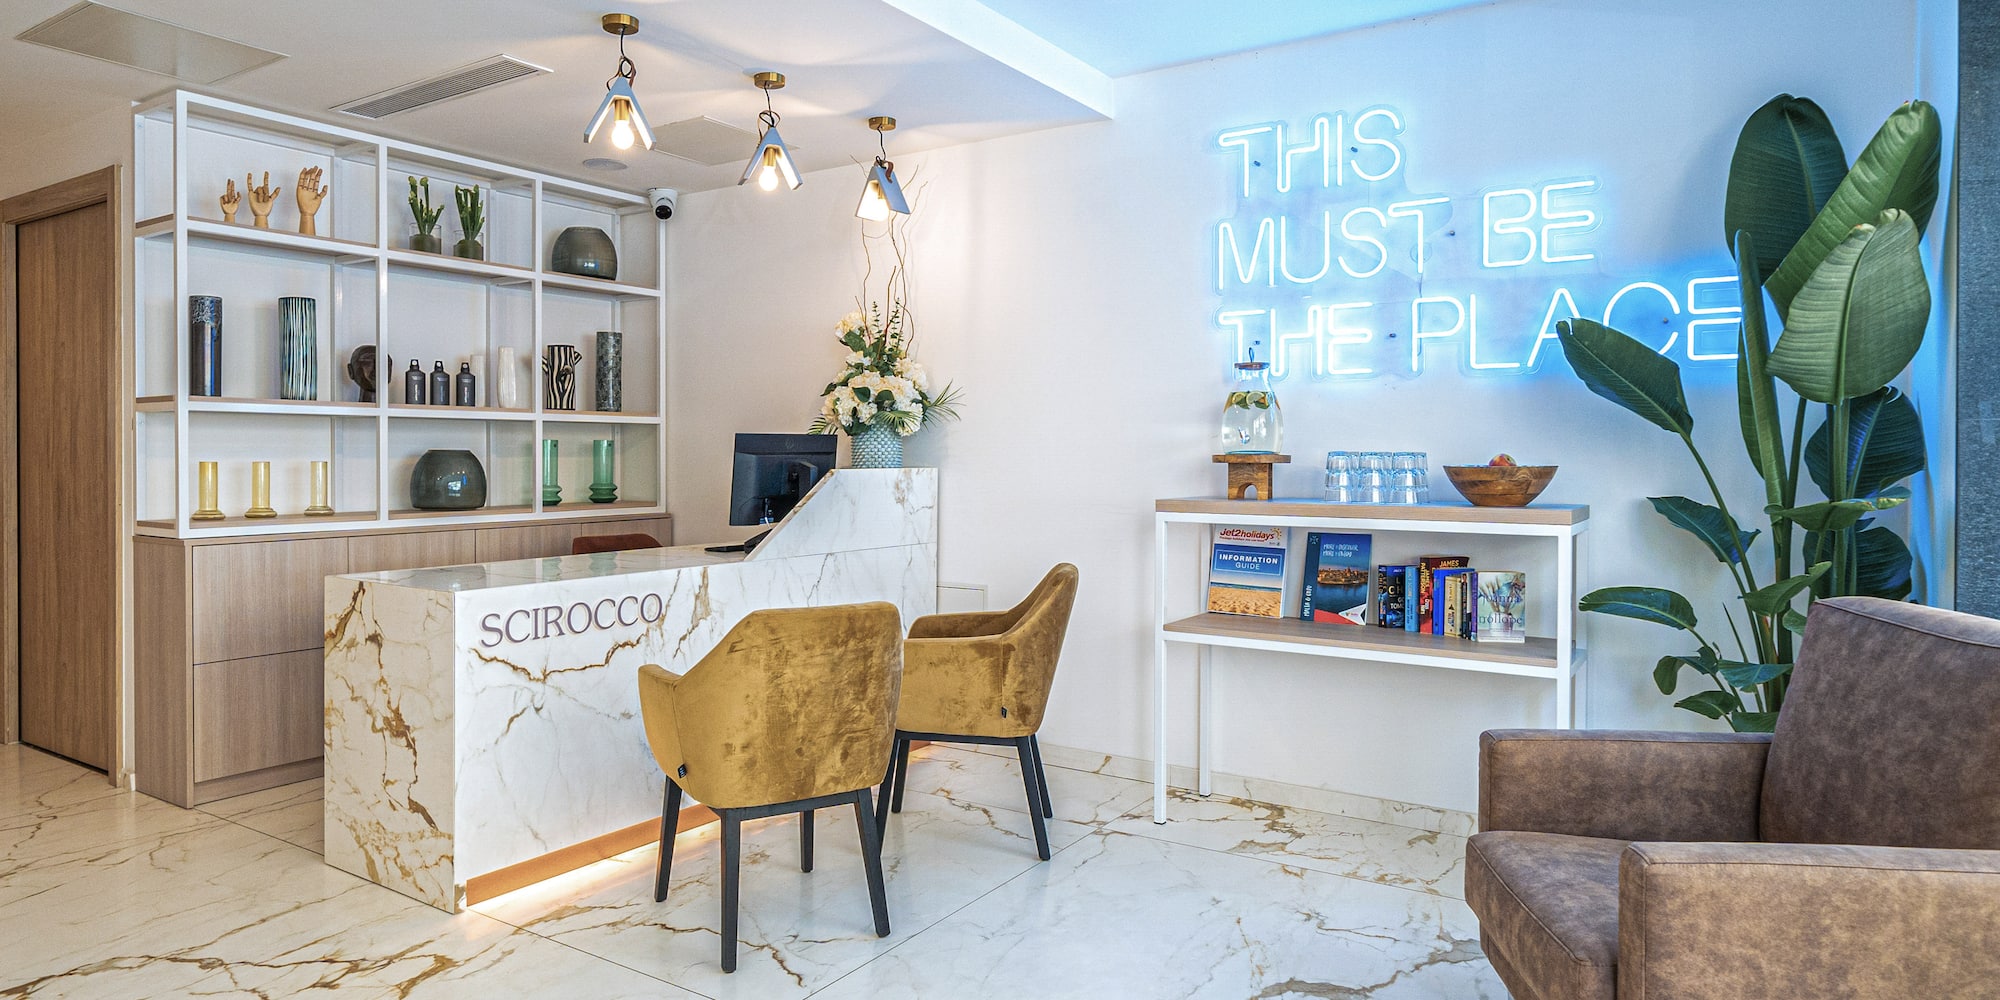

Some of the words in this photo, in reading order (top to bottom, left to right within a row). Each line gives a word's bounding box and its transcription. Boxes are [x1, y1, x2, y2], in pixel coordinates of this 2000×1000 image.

[1218, 108, 1402, 198] THIS
[1218, 197, 1451, 290] MUST
[1482, 180, 1596, 268] BE
[1218, 302, 1373, 377] THE
[1411, 276, 1743, 371] PLACE
[1219, 553, 1278, 564] INFORMATION
[1235, 562, 1261, 570] GUIDE
[1439, 560, 1460, 568] JAMES
[480, 592, 663, 649] SCIROCCO
[1478, 612, 1523, 627] trollope
